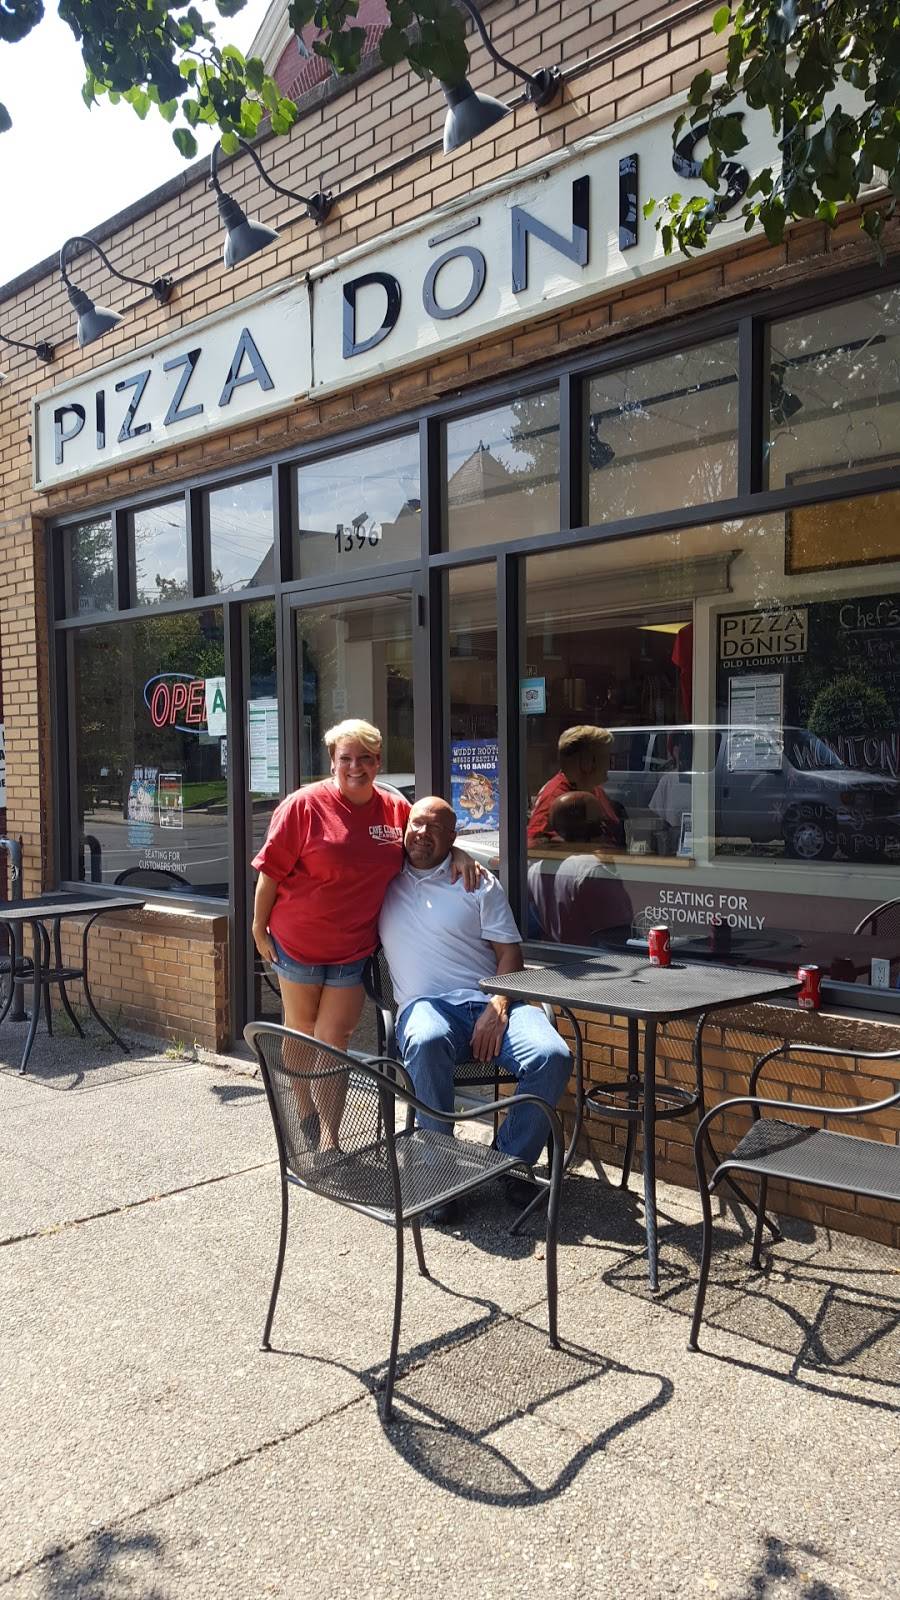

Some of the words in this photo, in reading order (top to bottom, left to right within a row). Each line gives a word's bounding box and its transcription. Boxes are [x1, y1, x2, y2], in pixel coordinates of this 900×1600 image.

[54, 327, 275, 465] PIZZA
[334, 521, 379, 553] 1396
[723, 613, 804, 637] PIZZA
[840, 600, 900, 629] Chef's
[723, 660, 743, 669] OLD
[746, 655, 805, 667] LOUISVILLE
[212, 688, 227, 714] A
[452, 747, 476, 756] MUDDY
[452, 756, 471, 764] MUSIC
[472, 762, 496, 770] BANDS
[145, 850, 168, 860] SEATING
[168, 852, 181, 861] FOR
[139, 860, 171, 871] CUSTOMERS
[171, 863, 187, 873] ONLY
[659, 890, 715, 908] SEATING
[719, 895, 748, 911] FOR
[644, 905, 722, 926] CUSTOMERS
[727, 913, 766, 930] ONLY
